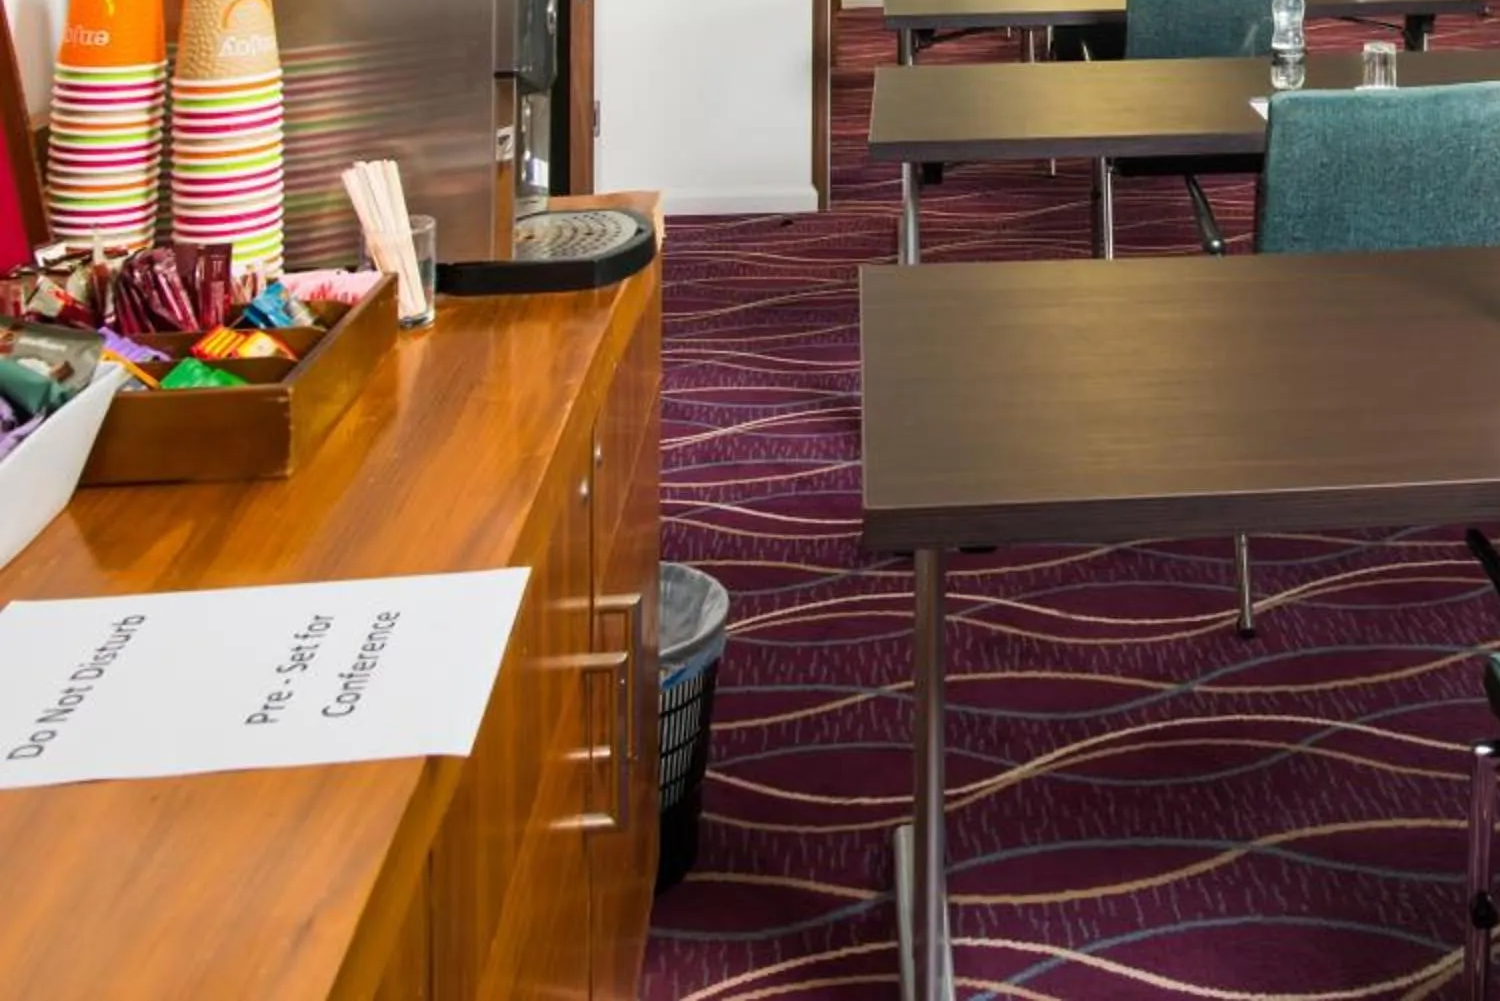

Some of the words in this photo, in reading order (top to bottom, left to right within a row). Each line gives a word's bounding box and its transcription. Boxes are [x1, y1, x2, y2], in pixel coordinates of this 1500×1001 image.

[294, 615, 334, 640] for
[276, 643, 320, 674] Set
[320, 611, 400, 717] Conference
[6, 730, 58, 760] Do
[35, 685, 94, 723] Not
[69, 615, 147, 681] Disturb
[245, 689, 294, 725] Pre
